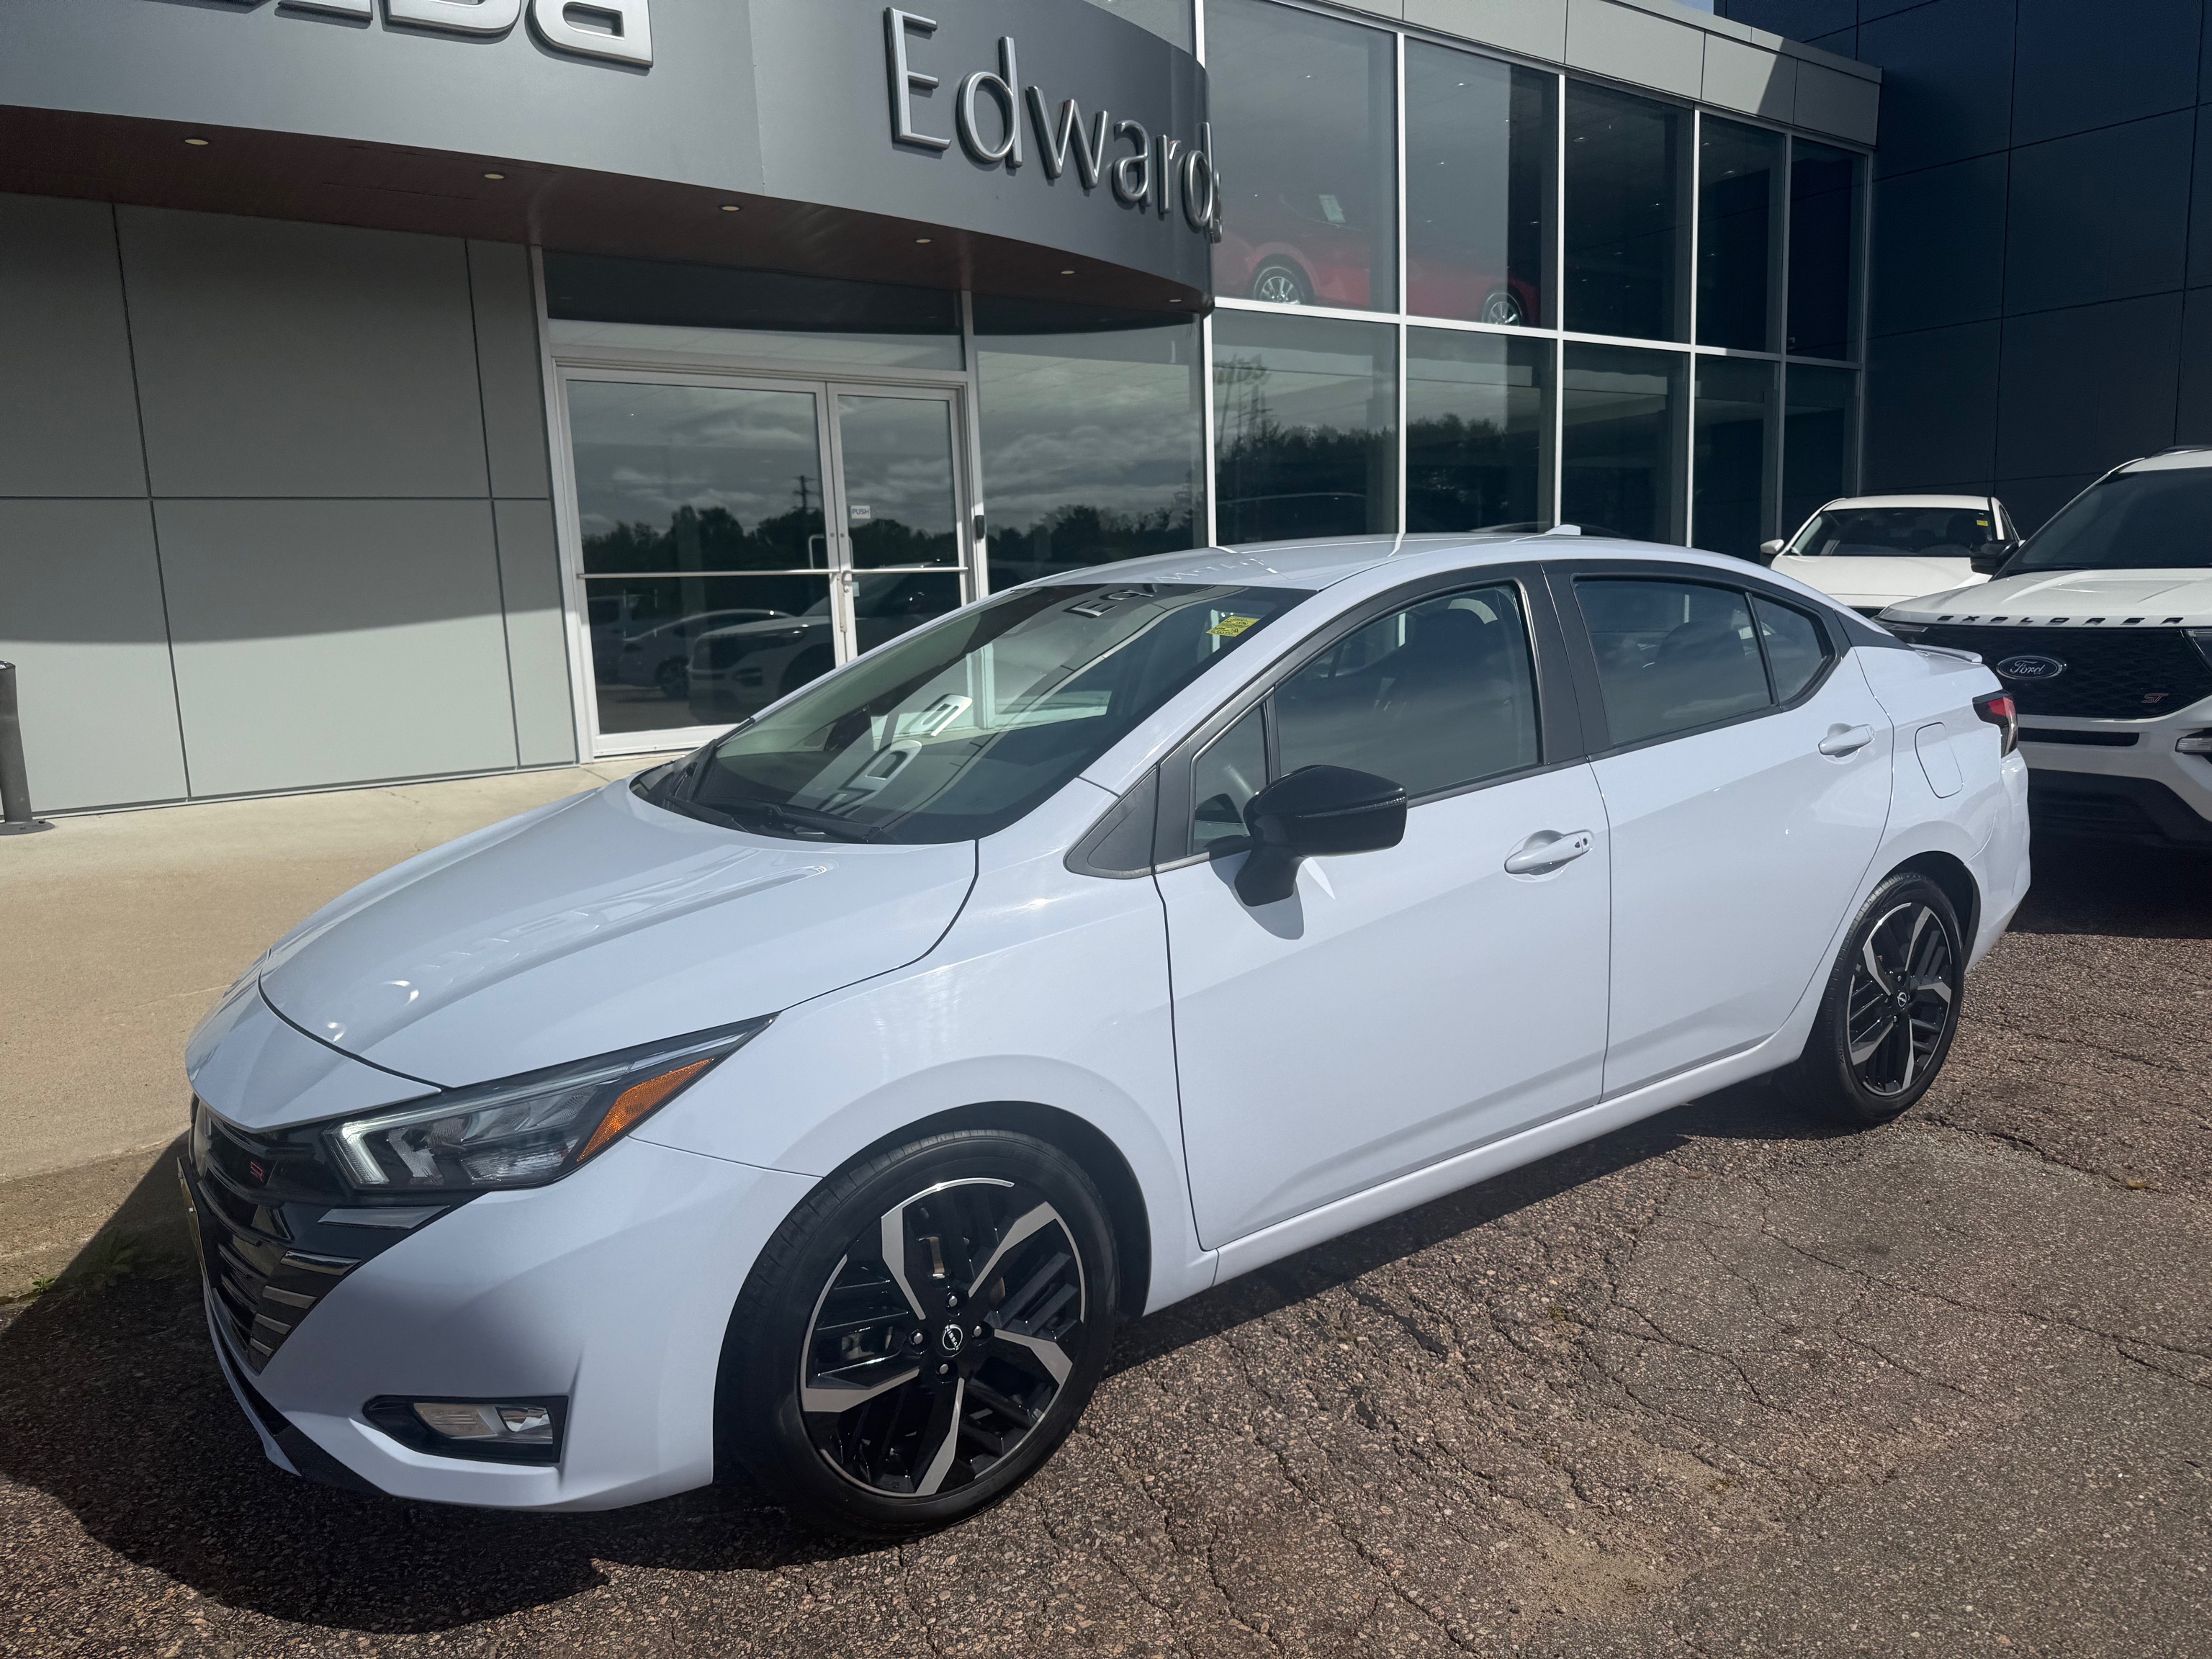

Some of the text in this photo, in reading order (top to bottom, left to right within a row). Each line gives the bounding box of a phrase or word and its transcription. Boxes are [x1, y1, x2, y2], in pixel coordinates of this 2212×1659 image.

[1936, 616, 2184, 625] EXPLORER
[2010, 660, 2046, 675] Ford
[2141, 693, 2170, 703] ST
